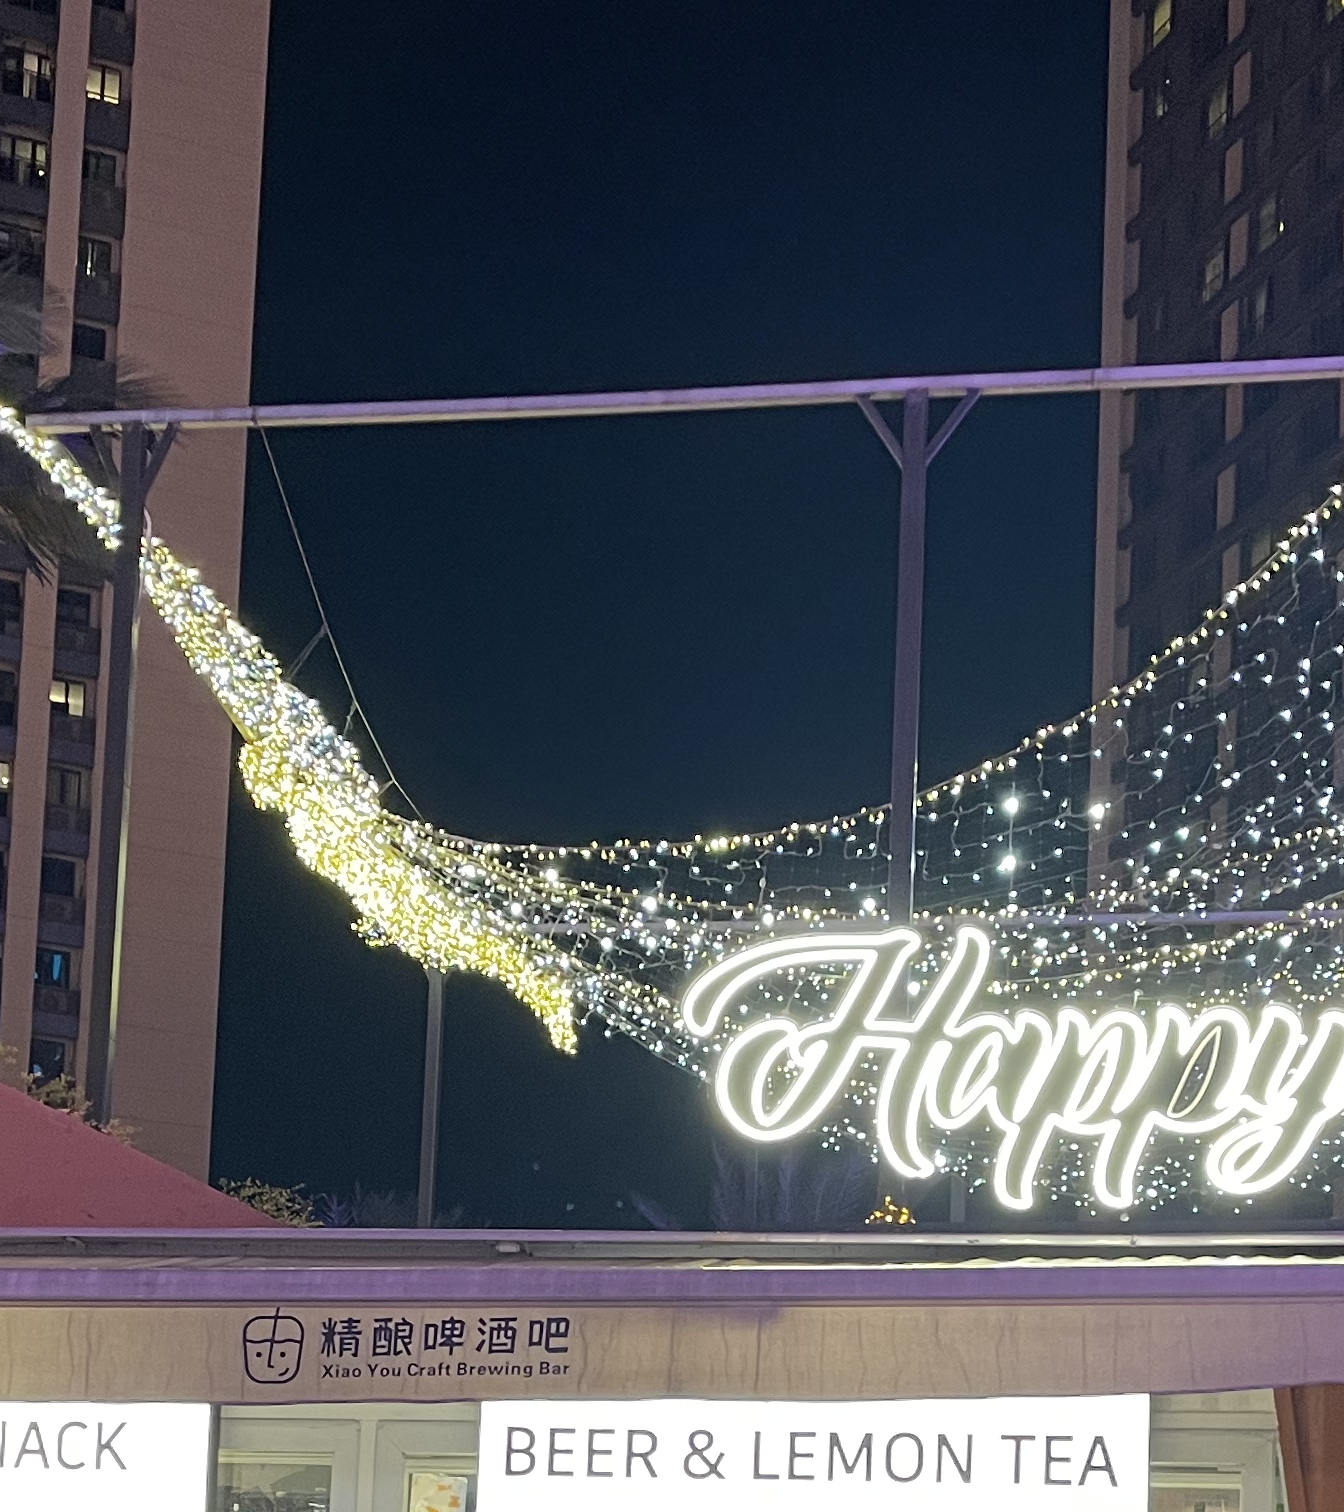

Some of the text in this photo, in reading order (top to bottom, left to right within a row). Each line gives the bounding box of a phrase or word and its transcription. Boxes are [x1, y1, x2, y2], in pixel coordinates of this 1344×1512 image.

[320, 1316, 571, 1358] 精酿啤酒吧
[322, 1361, 570, 1379] Xiao You Craft Brewing Bar
[503, 1426, 1119, 1488] BEER & LEMON TEA
